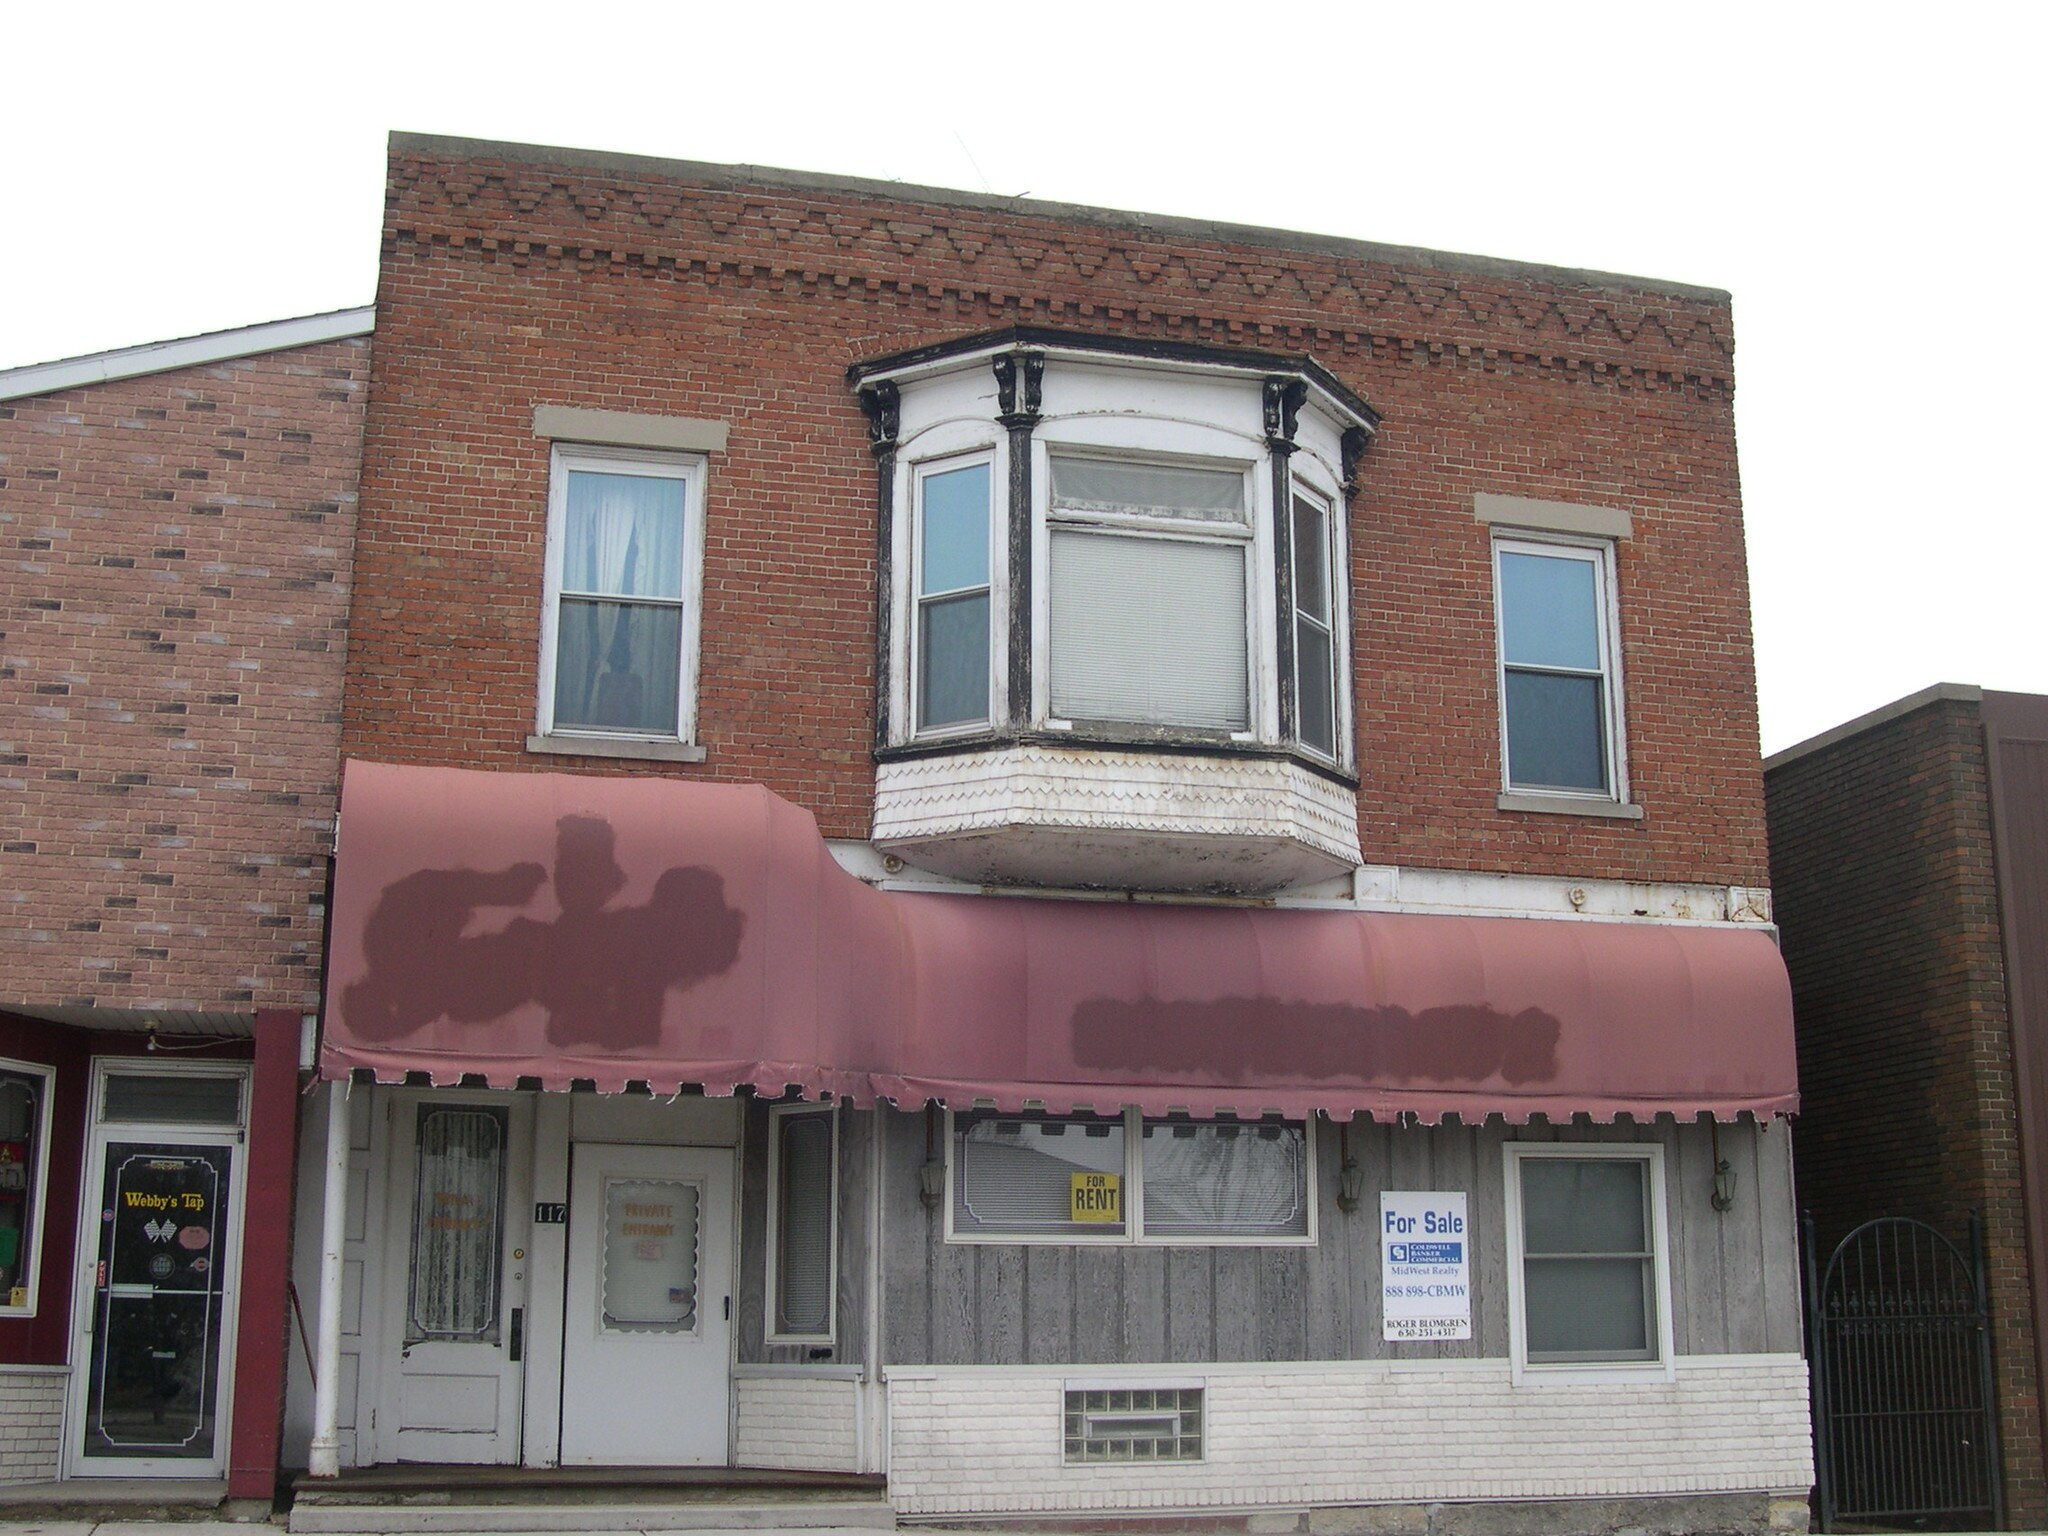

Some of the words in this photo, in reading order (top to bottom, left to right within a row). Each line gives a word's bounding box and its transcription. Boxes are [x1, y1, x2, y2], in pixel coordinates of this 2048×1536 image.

[1086, 1175, 1106, 1187] FOR
[125, 1191, 178, 1211] Webby's
[181, 1193, 205, 1211] Tap
[1076, 1188, 1117, 1210] RENT
[537, 1205, 566, 1222] 117
[1385, 1211, 1416, 1234] For
[1424, 1210, 1463, 1234] Sale
[1391, 1266, 1430, 1275] MidWest
[1432, 1266, 1459, 1277] Realty
[1385, 1286, 1403, 1297] 888
[1405, 1284, 1466, 1297] 898-CBMW
[1386, 1320, 1417, 1328] ROGER
[1419, 1318, 1467, 1328] BLOMGREN
